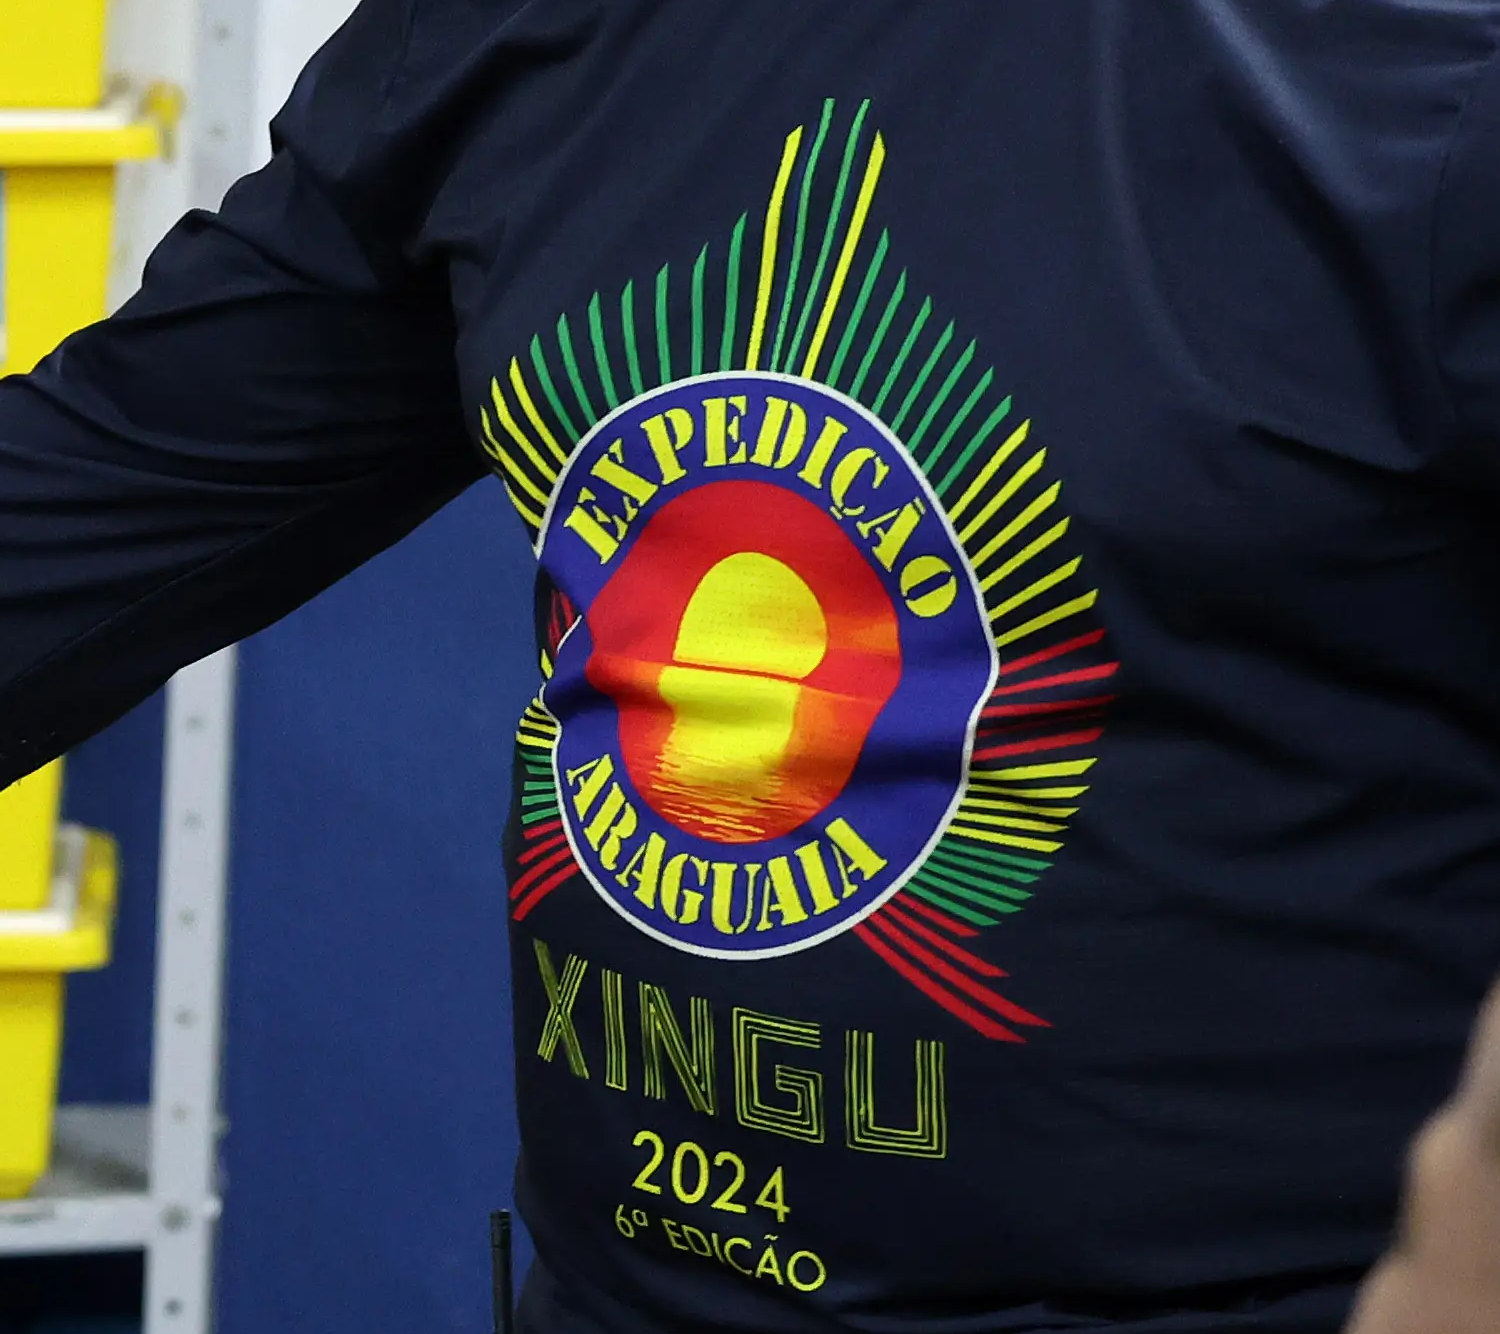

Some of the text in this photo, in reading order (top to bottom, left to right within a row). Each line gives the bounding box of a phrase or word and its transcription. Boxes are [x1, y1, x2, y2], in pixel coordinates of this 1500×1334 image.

[563, 395, 957, 618] EXPEDIÇÃO
[565, 753, 888, 935] ARAGUAIA
[532, 937, 948, 1159] XINGU
[631, 1129, 791, 1224] 2024
